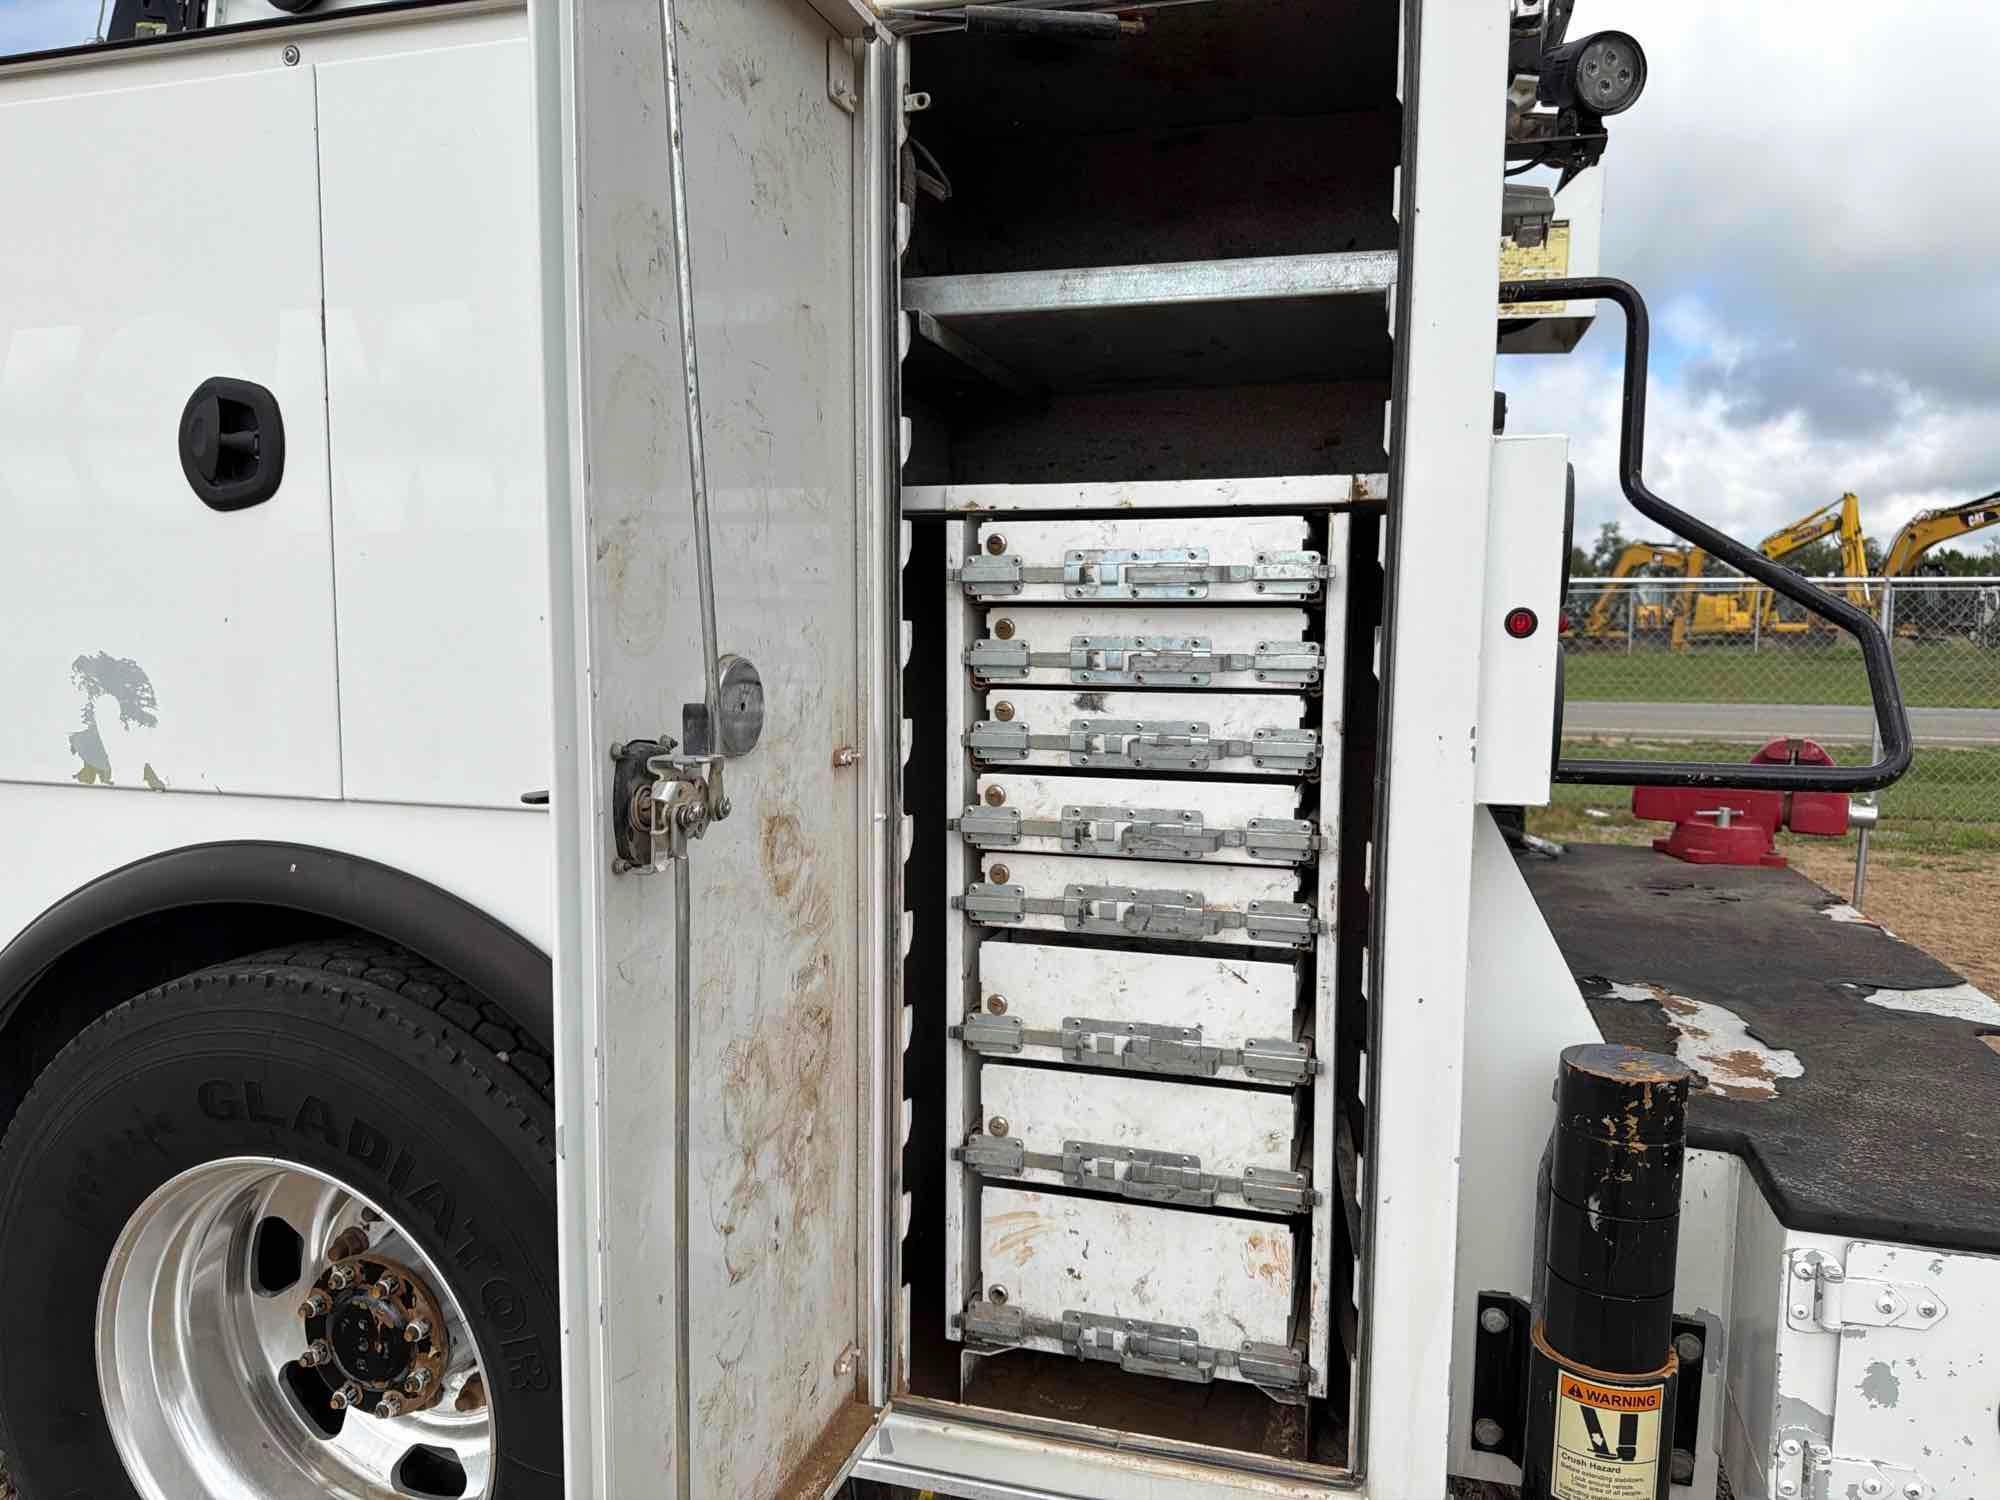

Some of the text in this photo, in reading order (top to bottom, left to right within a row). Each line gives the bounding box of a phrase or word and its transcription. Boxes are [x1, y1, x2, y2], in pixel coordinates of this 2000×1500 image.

[198, 1078, 550, 1394] GLADIATOR
[1586, 1389, 1656, 1407] WARNING
[1561, 1452, 1621, 1474] Crush Hazard
